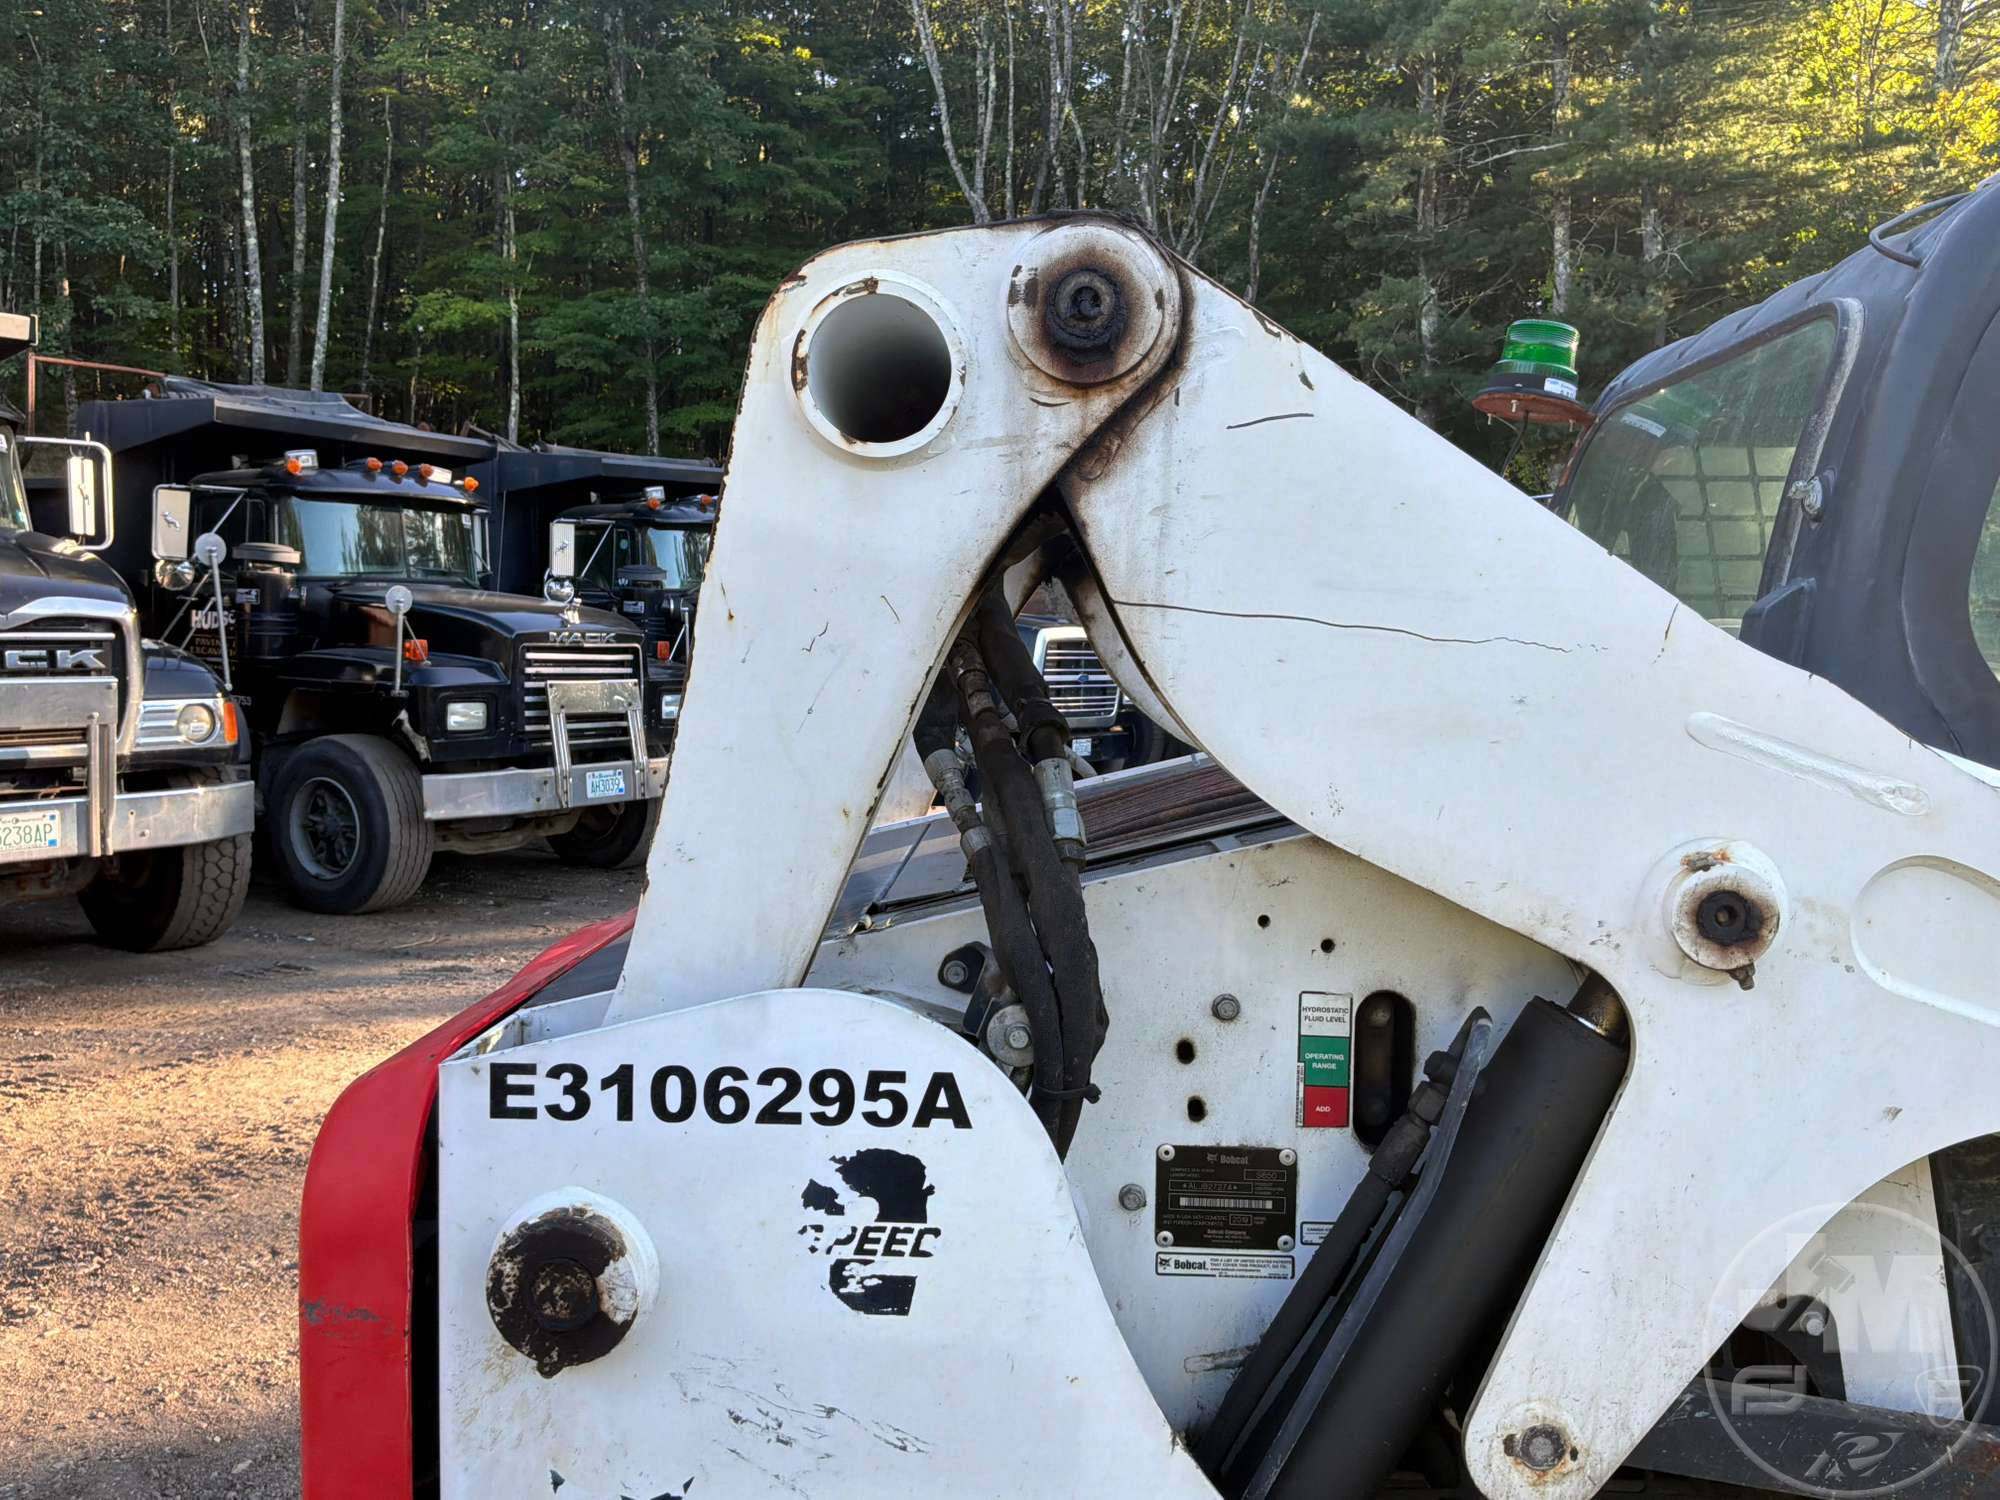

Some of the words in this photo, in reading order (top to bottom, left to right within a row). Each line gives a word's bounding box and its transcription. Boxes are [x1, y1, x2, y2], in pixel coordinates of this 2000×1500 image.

[548, 631, 617, 644] MACK
[0, 823, 52, 848] 238AP
[1302, 1006, 1349, 1014] HYDROSTATIC
[1304, 1052, 1344, 1060] OPERATING
[1312, 1062, 1337, 1070] RANGE
[489, 1062, 973, 1129] E3106295A
[1220, 1154, 1248, 1165] Bobcat
[1174, 1259, 1206, 1270] Bobcat
